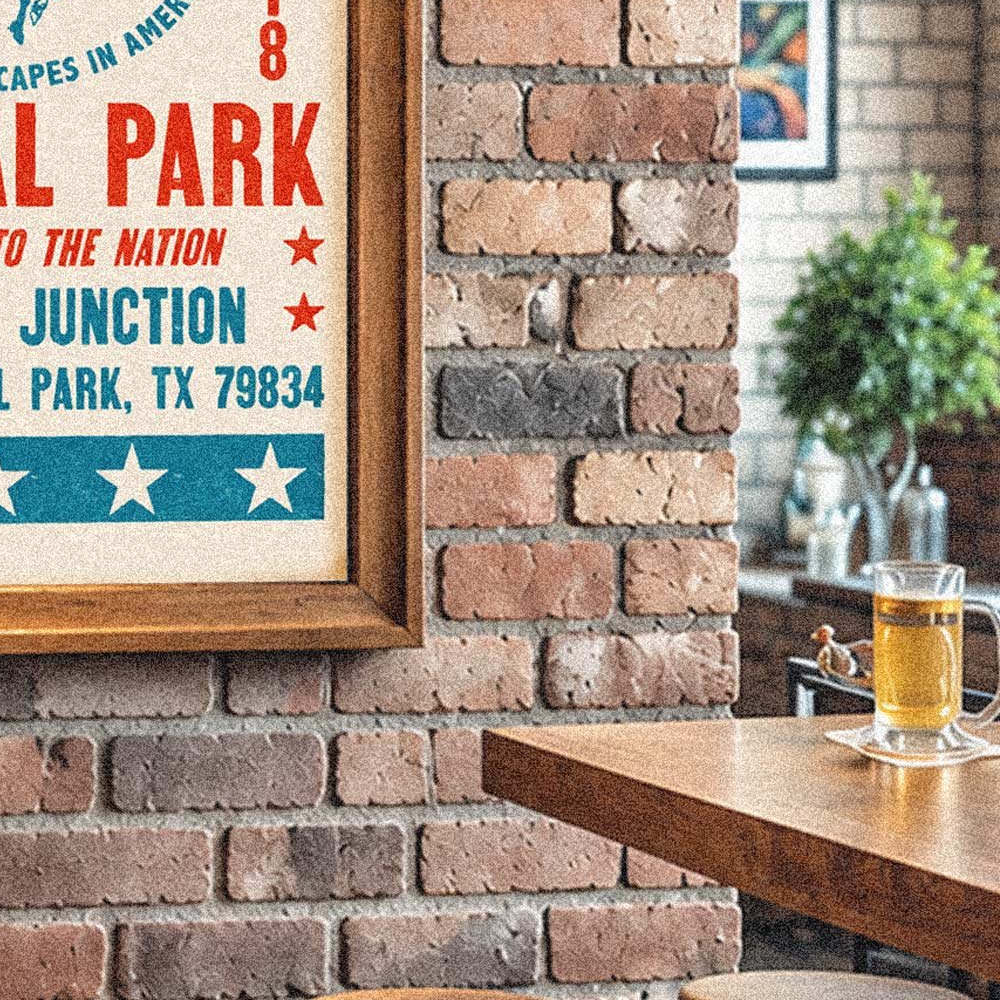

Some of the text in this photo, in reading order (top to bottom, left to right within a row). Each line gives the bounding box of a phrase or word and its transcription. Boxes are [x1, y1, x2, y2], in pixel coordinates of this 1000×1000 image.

[86, 43, 118, 74] IN
[105, 101, 326, 209] PARK
[42, 227, 103, 268] THE
[113, 226, 228, 268] NATION
[19, 287, 246, 346] JUNCTION
[31, 367, 132, 415] PARK,
[153, 366, 193, 409] TX
[215, 365, 324, 409] 79834
